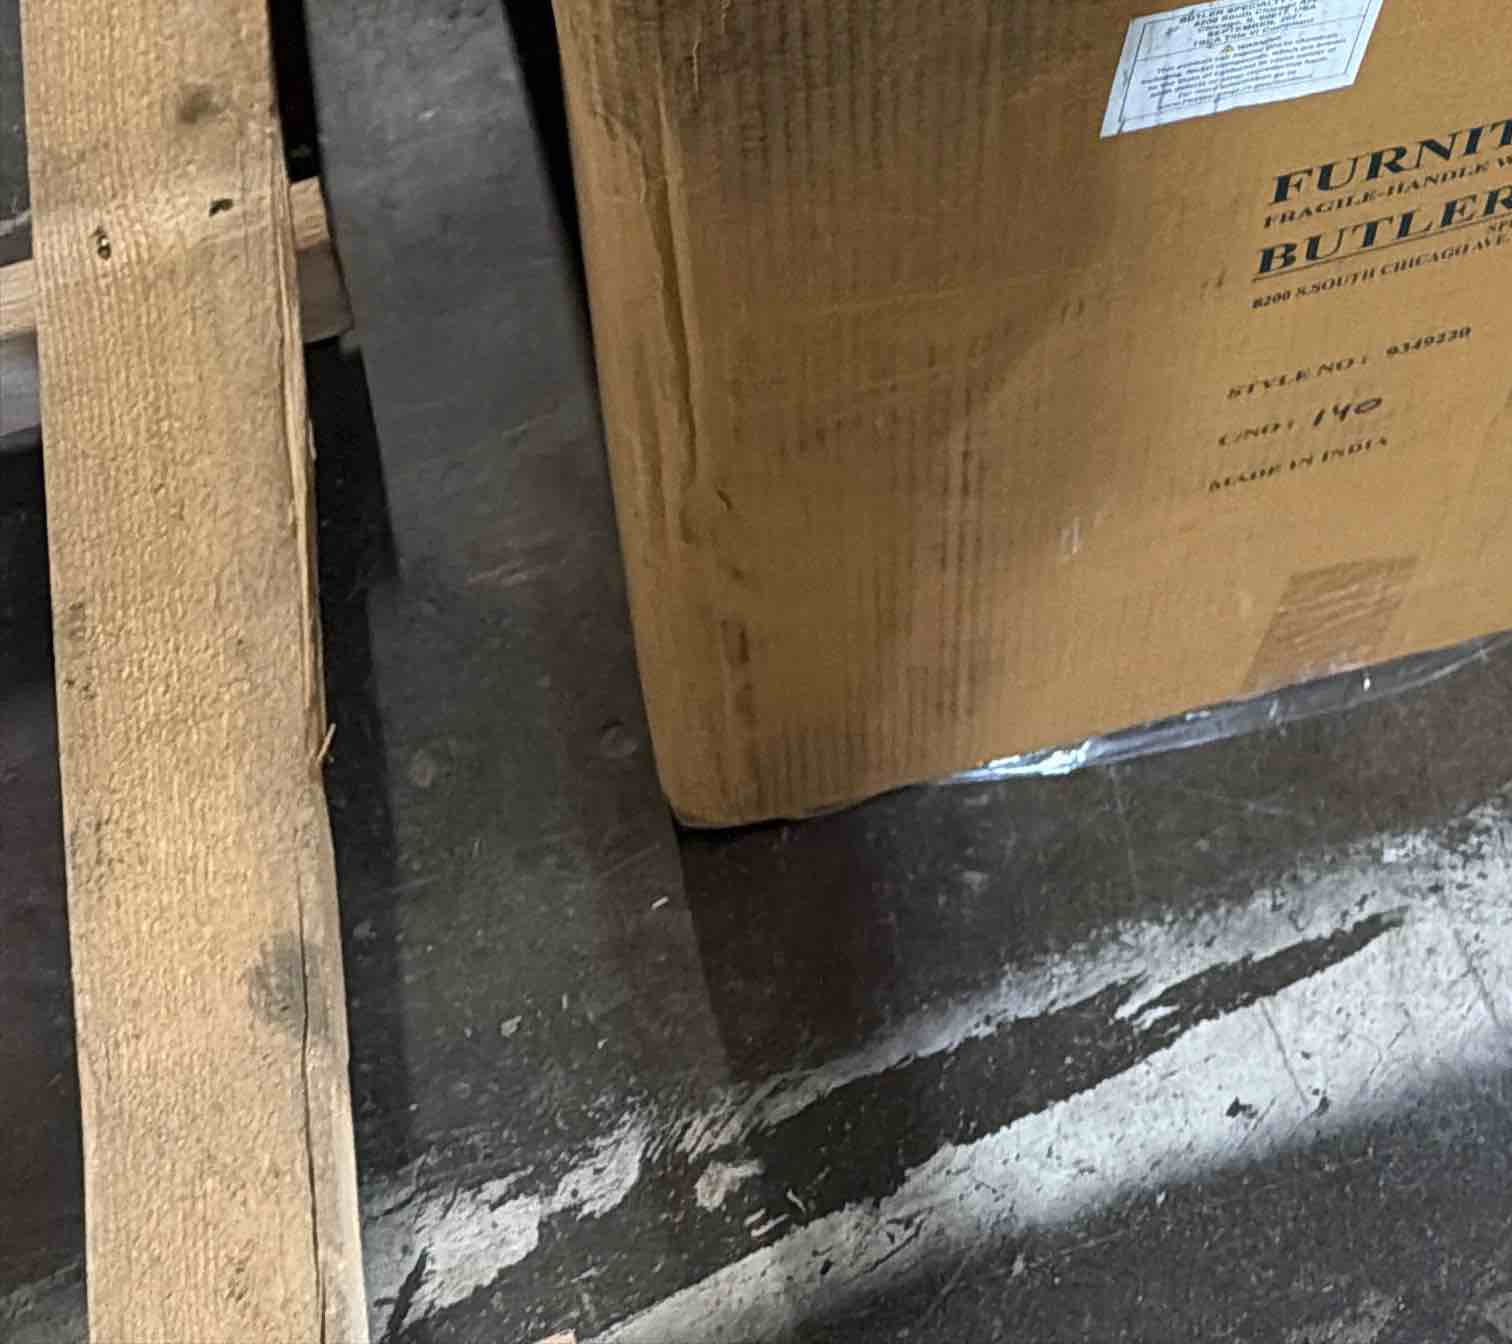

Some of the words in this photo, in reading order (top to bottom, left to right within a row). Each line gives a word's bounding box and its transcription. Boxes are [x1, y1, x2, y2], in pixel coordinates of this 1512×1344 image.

[1379, 245, 1469, 276] CHICAGO
[1226, 367, 1312, 401] STYLE
[1312, 396, 1384, 428] 140
[1208, 463, 1282, 494] MADE
[1288, 453, 1315, 472] IN
[1320, 435, 1390, 463] INDIA
